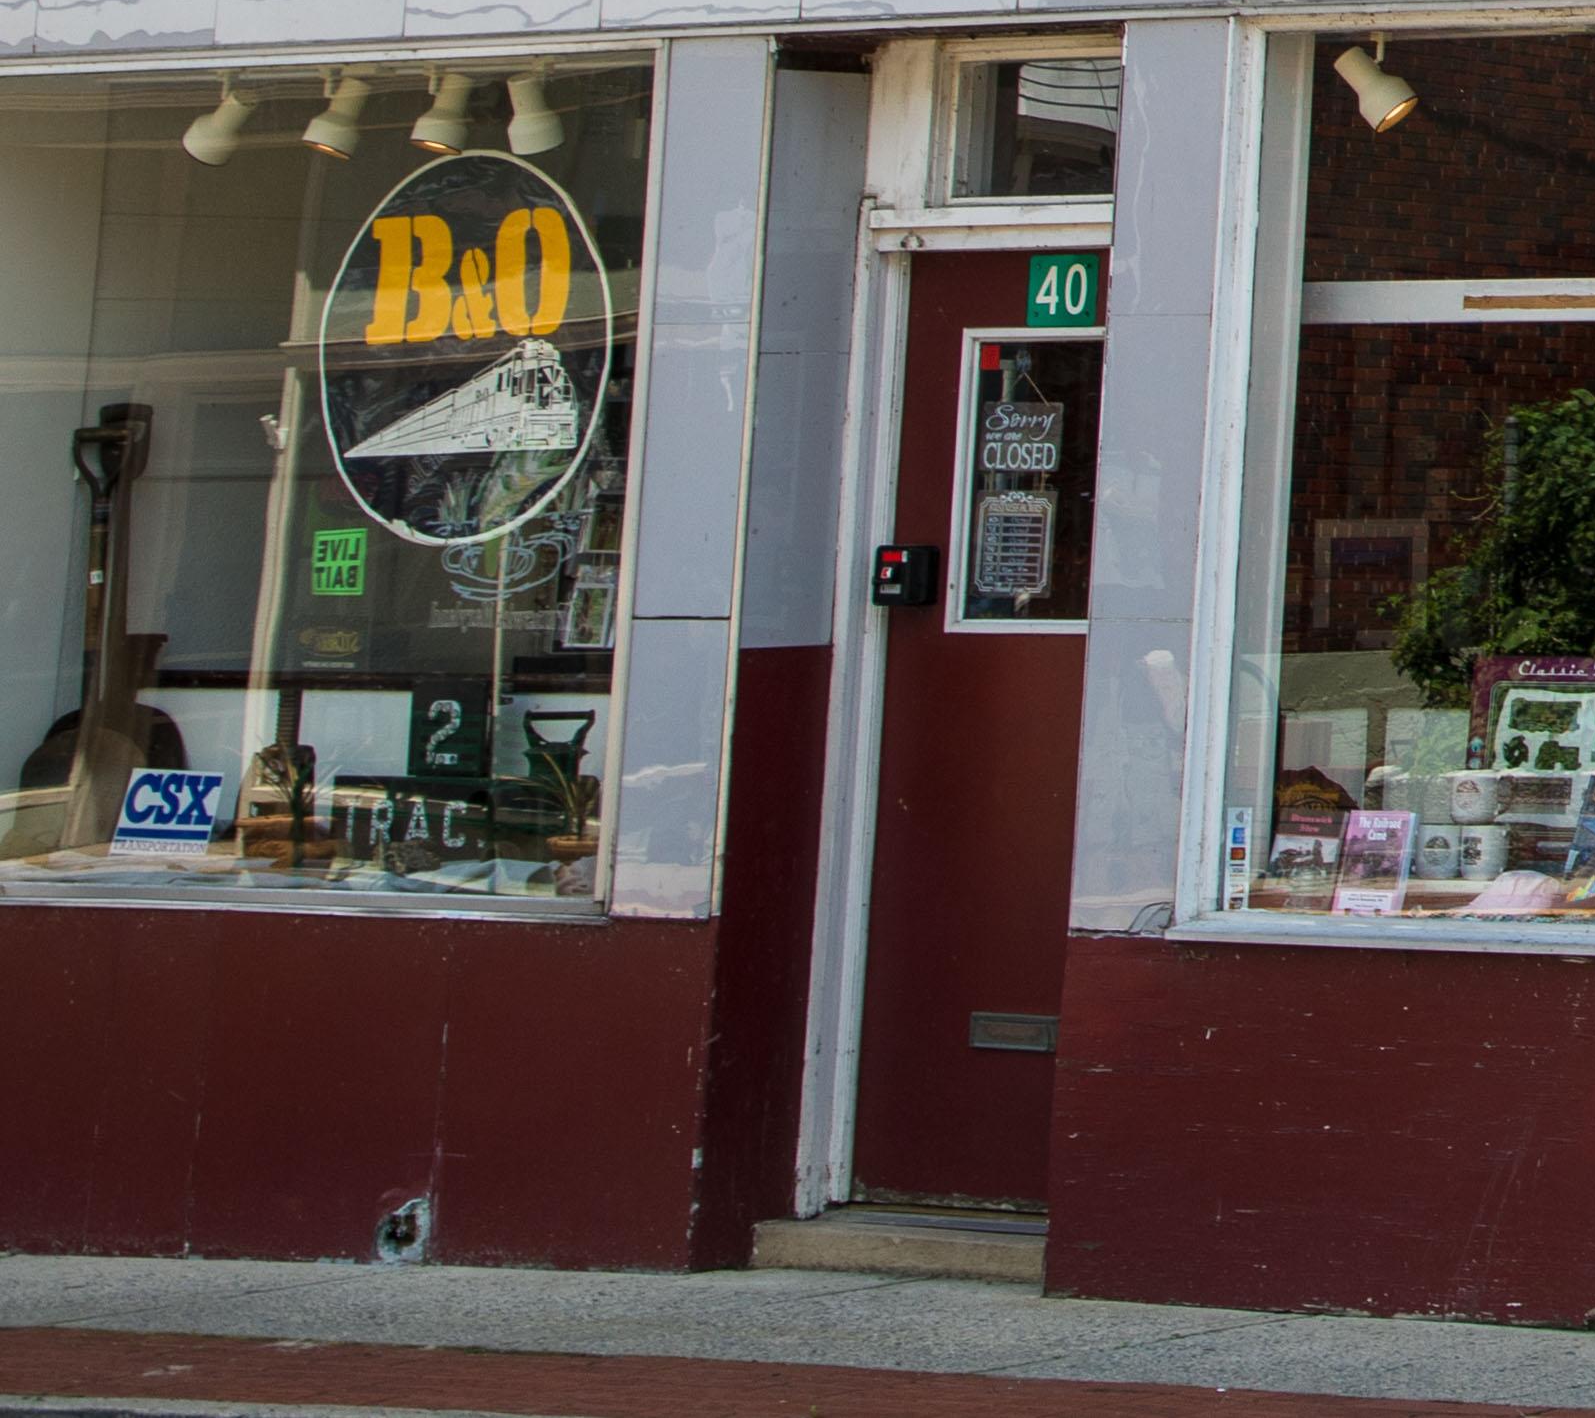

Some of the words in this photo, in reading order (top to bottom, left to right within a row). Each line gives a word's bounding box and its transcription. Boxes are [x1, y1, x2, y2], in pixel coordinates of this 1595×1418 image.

[366, 207, 571, 346] B&O
[1035, 263, 1087, 315] 40
[985, 404, 1057, 440] Sorry
[983, 443, 1056, 469] CLOSED
[1518, 661, 1588, 677] Classic
[425, 699, 462, 765] 2
[125, 773, 223, 825] CSX
[111, 841, 207, 854] TRANSPORTATION
